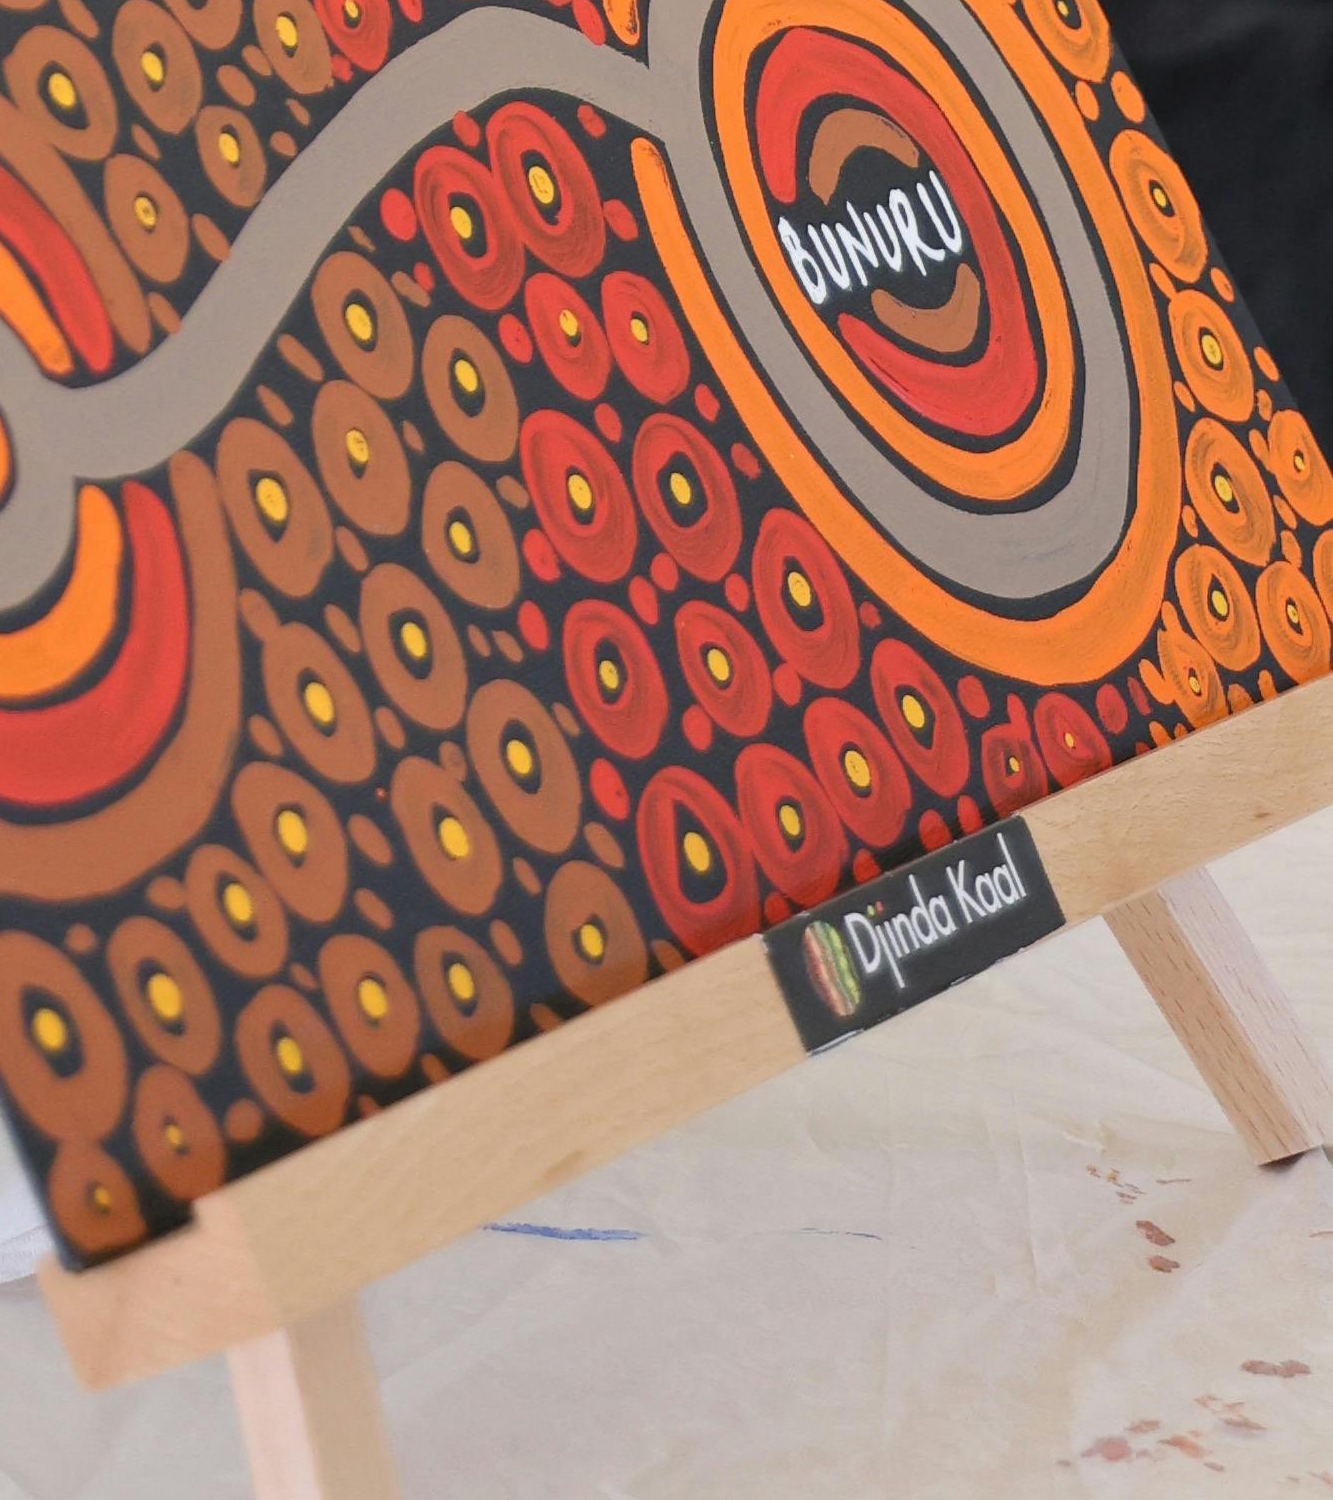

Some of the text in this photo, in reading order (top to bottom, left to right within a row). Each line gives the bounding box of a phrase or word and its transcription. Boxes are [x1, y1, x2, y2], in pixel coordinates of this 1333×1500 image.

[777, 169, 962, 306] BUNURU
[843, 833, 1028, 989] Djinda Kaal
